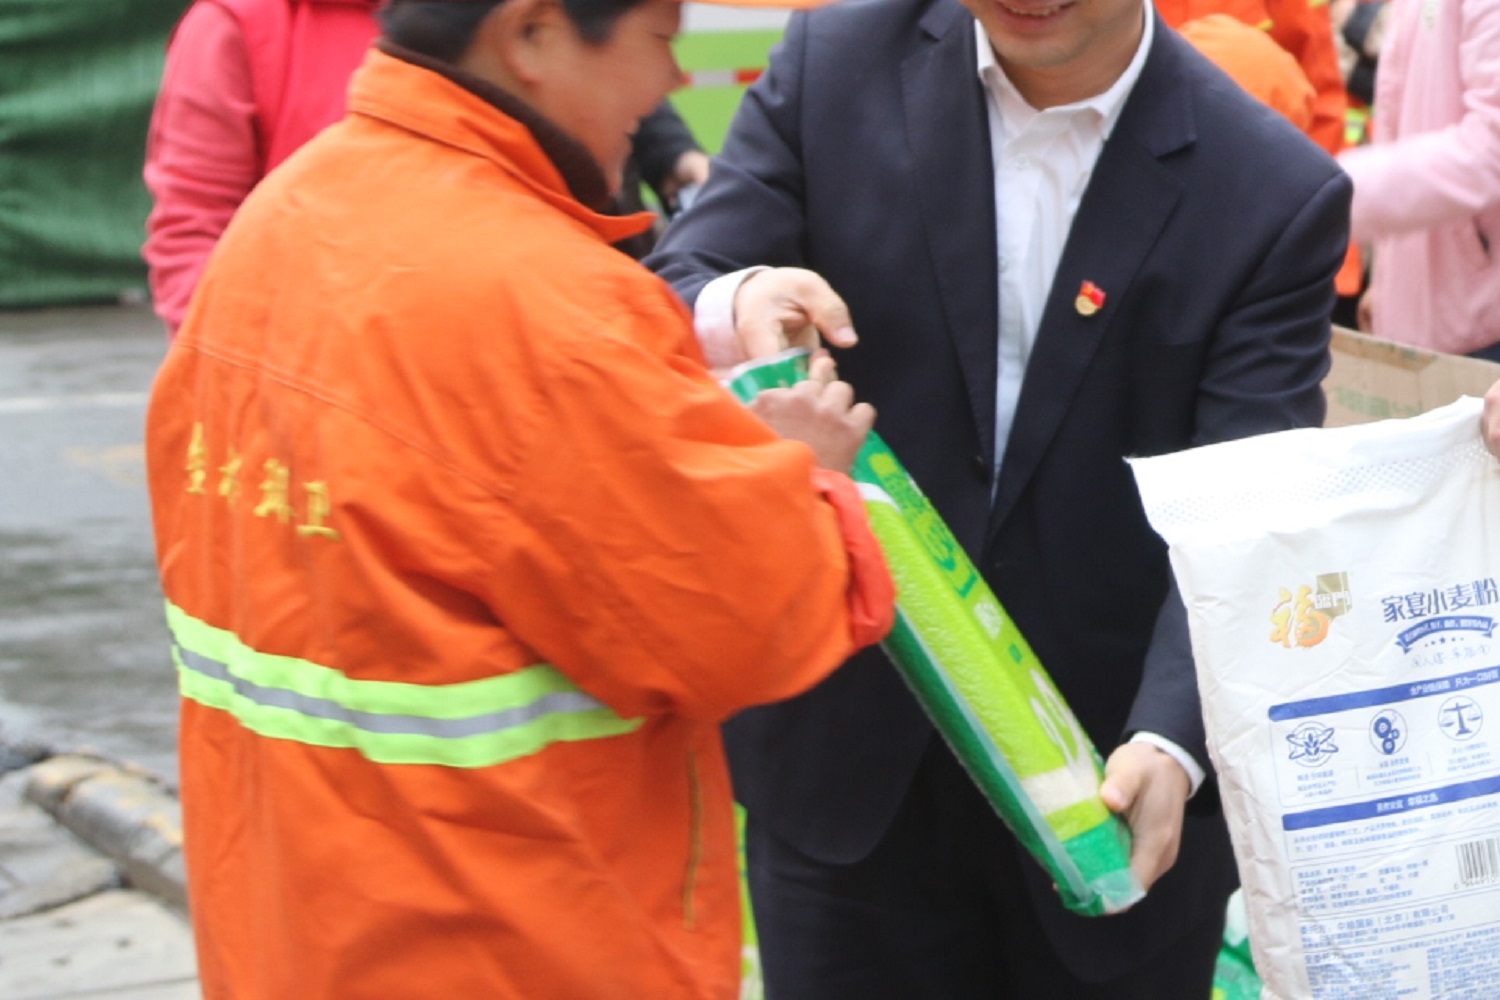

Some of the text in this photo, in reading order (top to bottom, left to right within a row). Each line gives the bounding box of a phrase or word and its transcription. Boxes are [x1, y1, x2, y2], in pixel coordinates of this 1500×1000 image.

[1381, 578, 1499, 622] 家宴小麦粉
